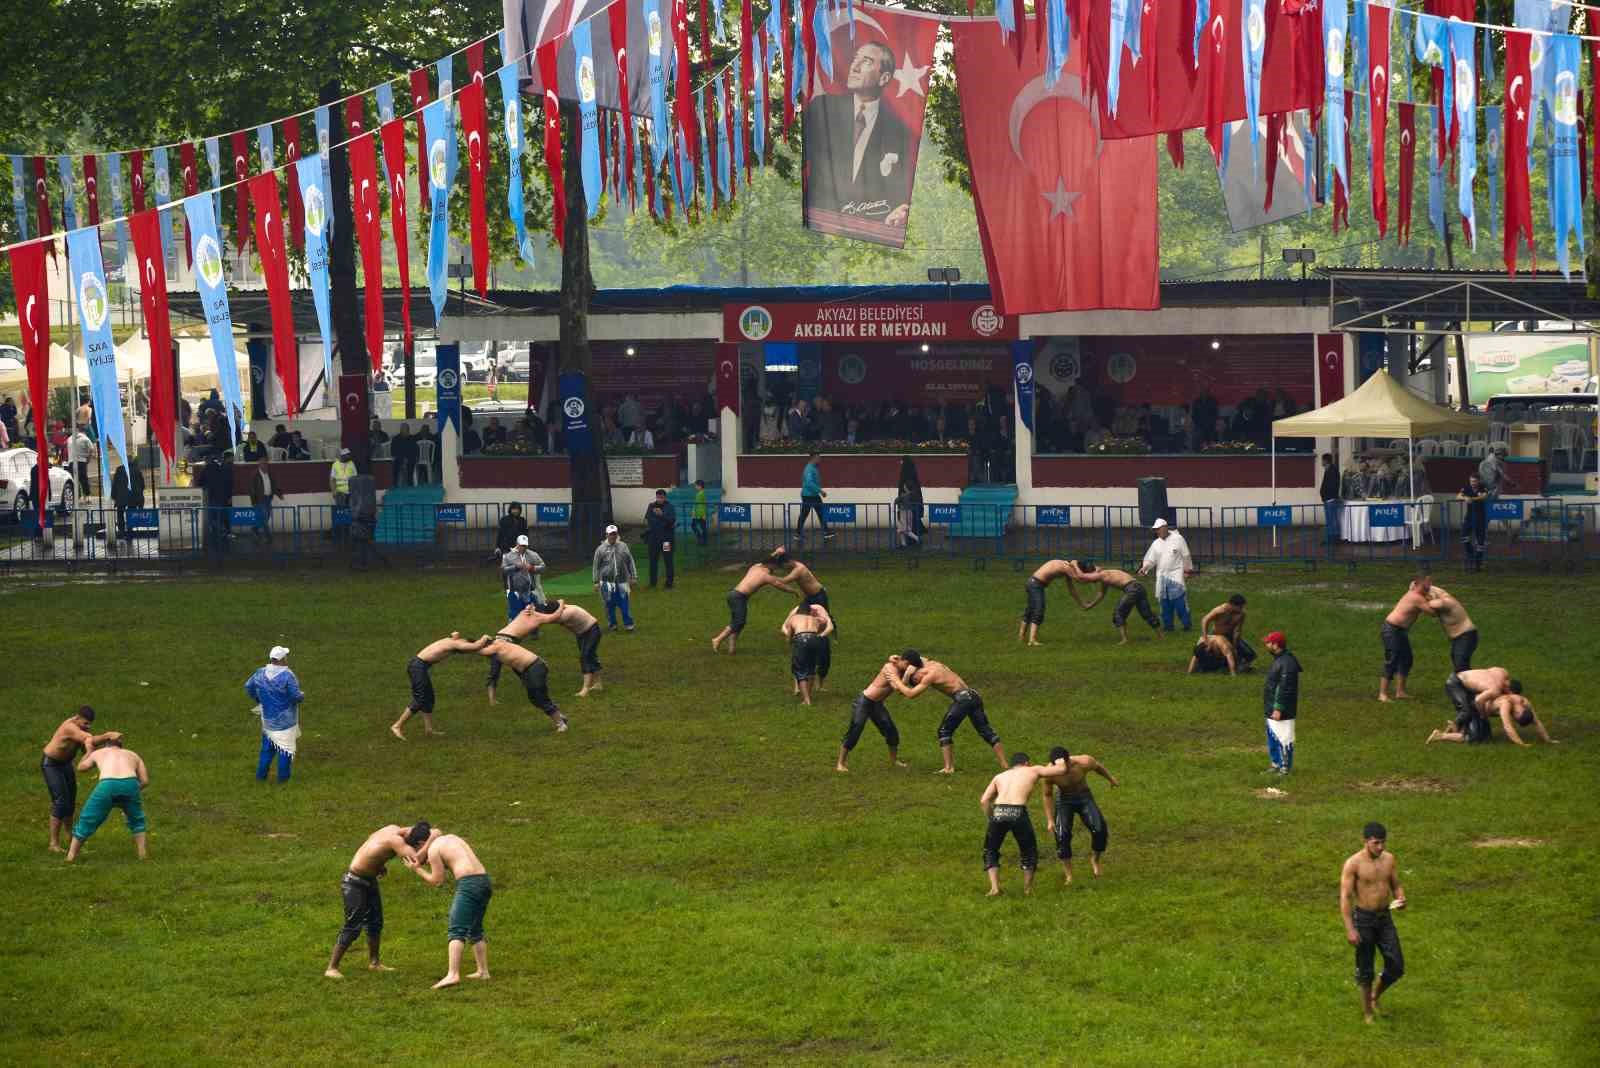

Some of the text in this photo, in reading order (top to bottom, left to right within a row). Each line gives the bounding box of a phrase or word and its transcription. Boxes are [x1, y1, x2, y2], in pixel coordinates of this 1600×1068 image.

[816, 304, 924, 321] AKYAZI BELEDİYESİ
[794, 322, 947, 337] AKBALIK ER MEYDANI
